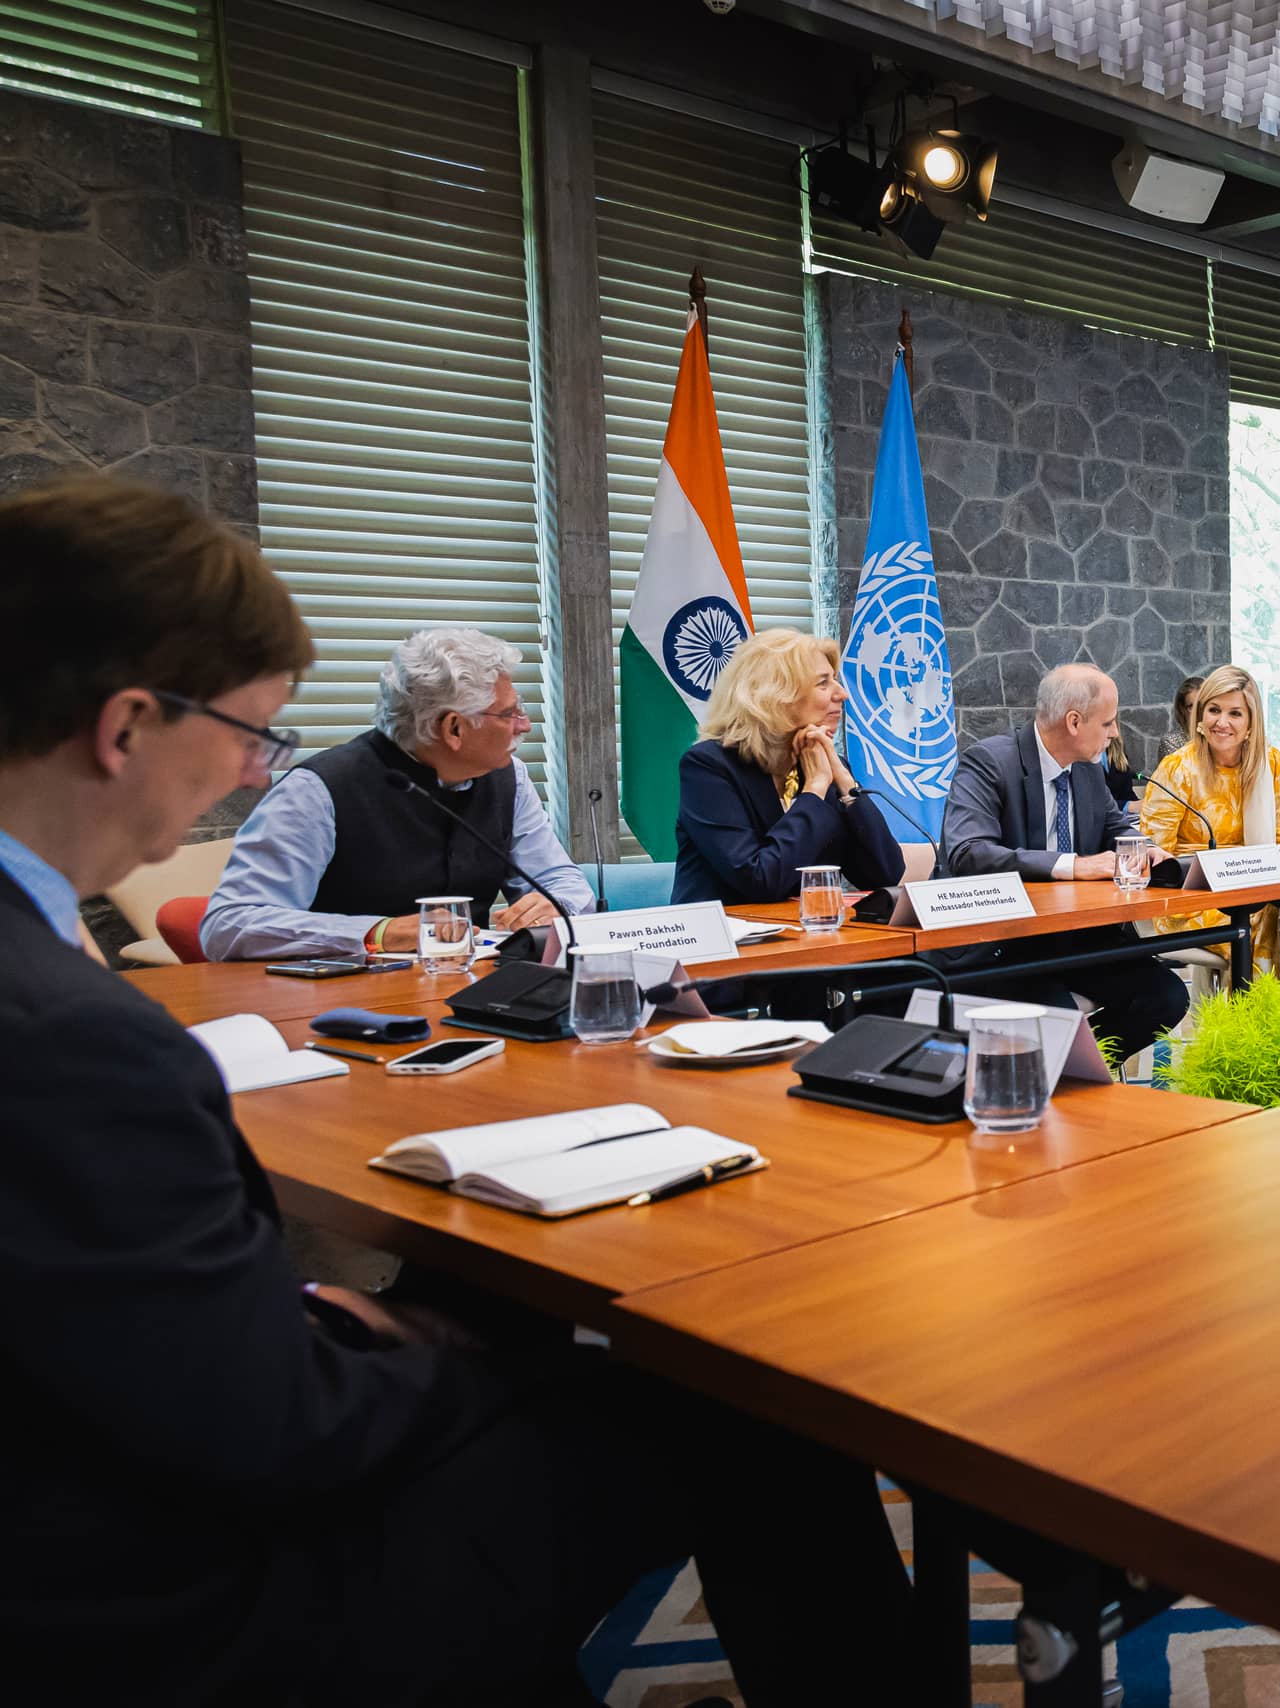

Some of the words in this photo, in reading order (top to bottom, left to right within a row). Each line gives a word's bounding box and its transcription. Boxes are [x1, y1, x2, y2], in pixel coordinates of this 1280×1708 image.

[937, 892, 949, 900] HE
[949, 890, 973, 900] Marisa
[973, 887, 1001, 897] Gerards
[930, 902, 974, 913] Ambassador
[974, 896, 1017, 908] Netherlands
[609, 928, 644, 940] Pawan
[645, 922, 686, 936] Bakhshi
[639, 936, 697, 951] Foundation
